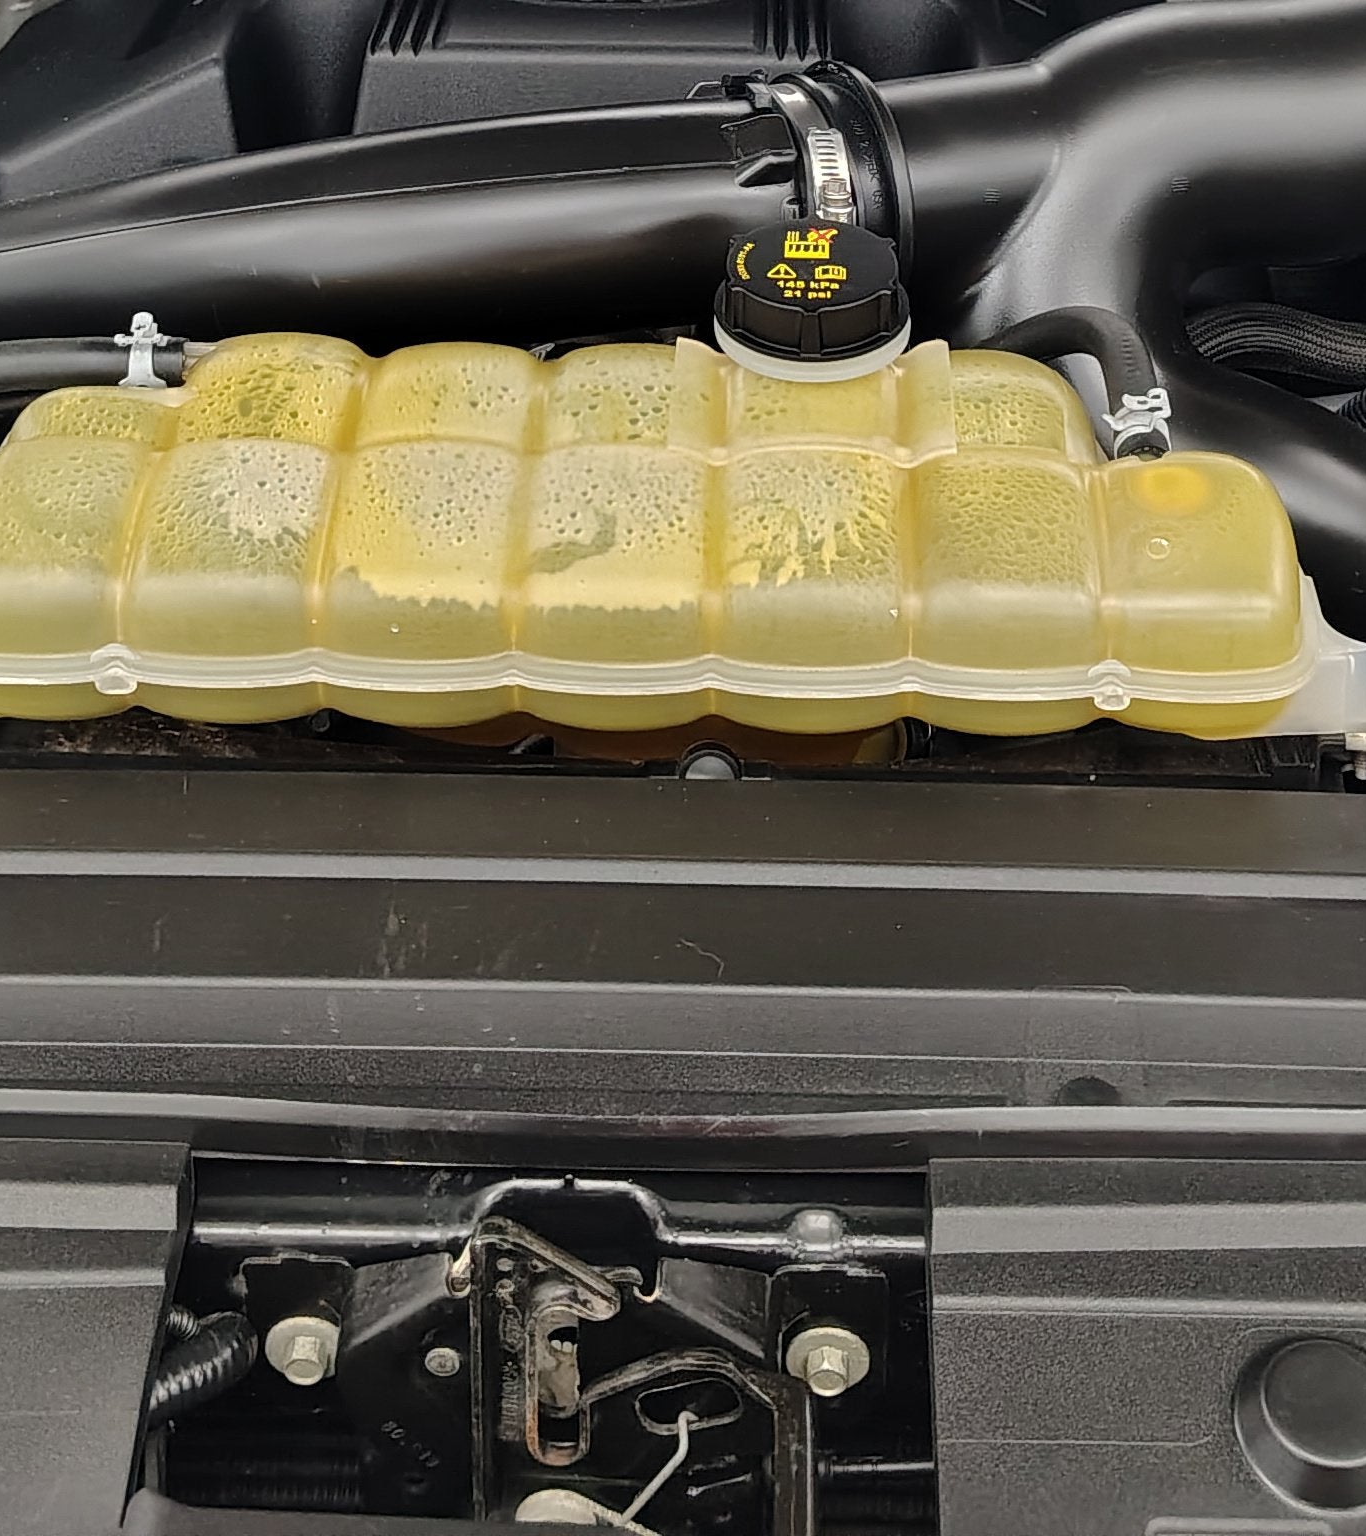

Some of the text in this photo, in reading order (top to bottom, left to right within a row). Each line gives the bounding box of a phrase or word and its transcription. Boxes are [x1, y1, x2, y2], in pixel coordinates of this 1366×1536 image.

[776, 280, 840, 290] 145 kPa
[783, 290, 832, 300] 21 psi
